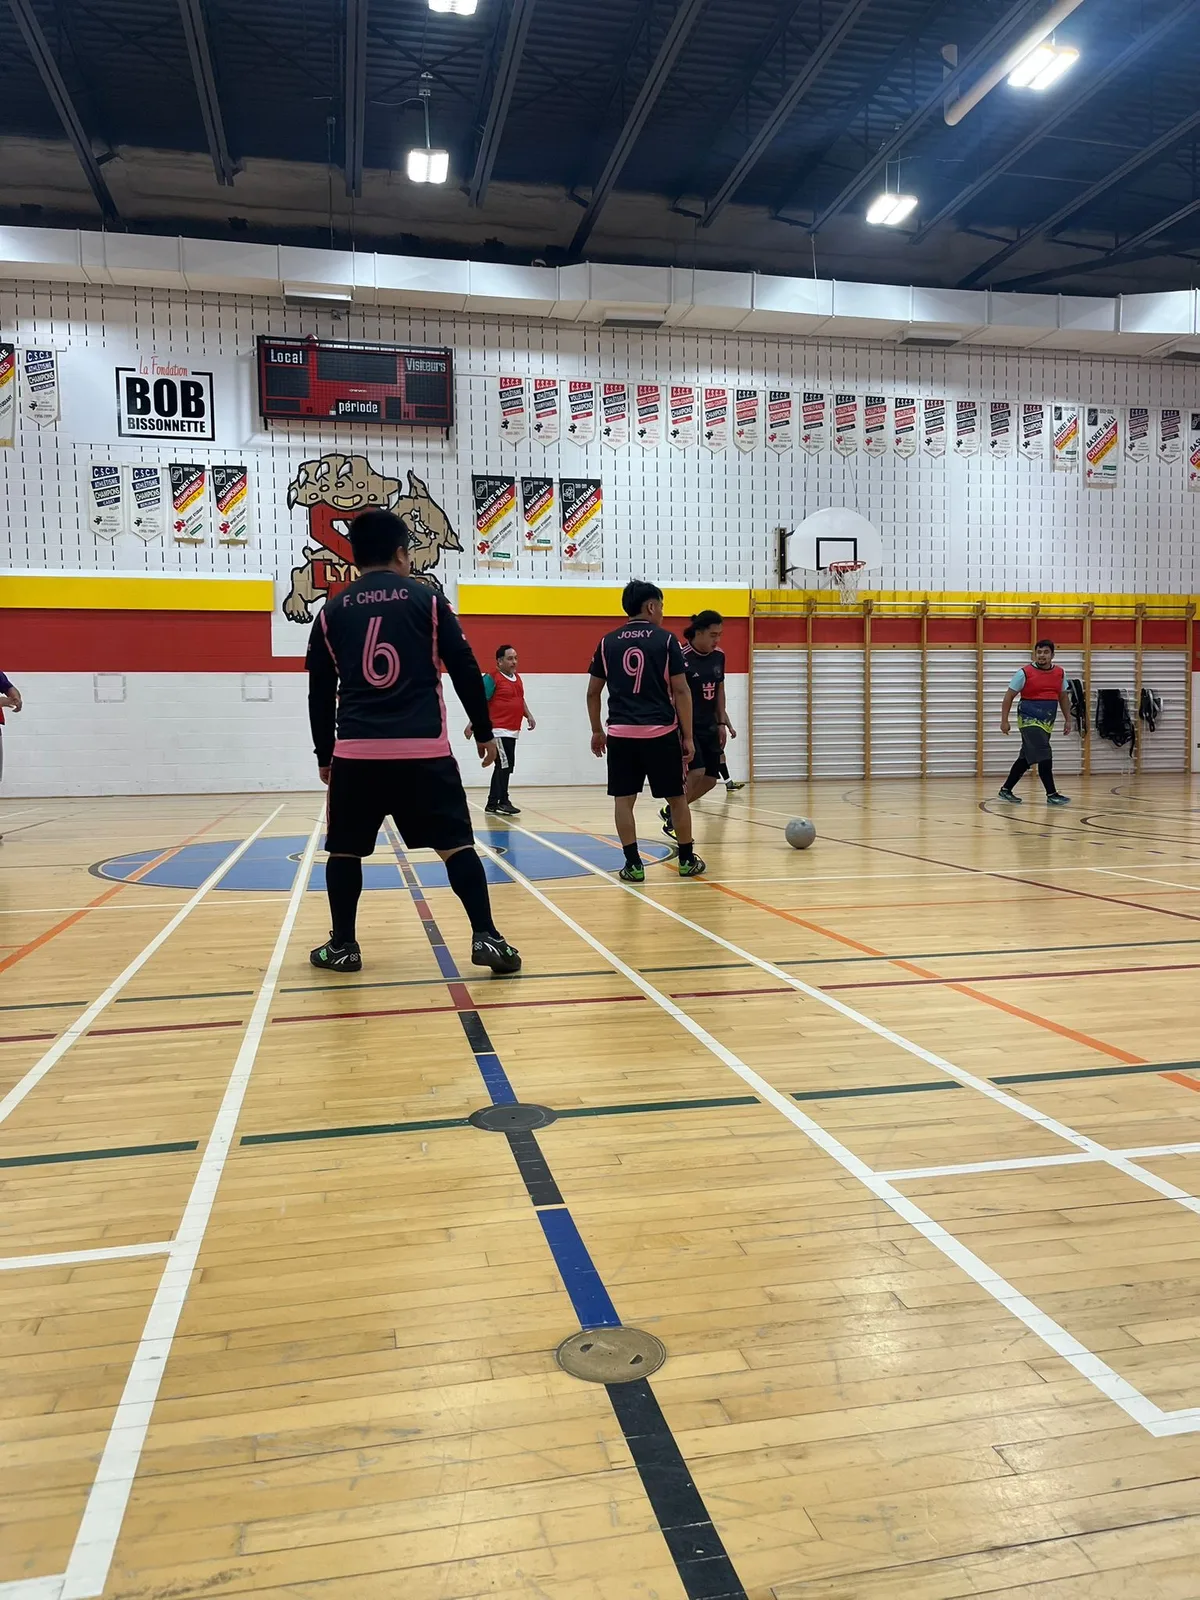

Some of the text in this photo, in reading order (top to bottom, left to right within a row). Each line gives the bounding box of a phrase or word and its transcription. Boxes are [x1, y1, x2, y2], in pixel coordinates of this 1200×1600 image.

[140, 355, 188, 376] La Fondation
[270, 349, 302, 364] Local
[405, 357, 446, 372] Visiteurs
[28, 372, 54, 384] CHAMPIONS
[126, 377, 205, 418] BOB
[338, 401, 378, 415] période
[571, 402, 593, 412] CHAMPIONS
[604, 405, 625, 416] CHAMPIONS
[128, 417, 206, 433] BISSONNETTE
[671, 407, 692, 417] CHAMPIONS
[1086, 416, 1116, 448] BASKET-BALL
[1088, 429, 1115, 459] CHAMPIONS
[95, 487, 119, 499] CHAMPIONS
[136, 488, 160, 500] CHAMPIONS
[174, 470, 201, 497] BASKET-BALL
[174, 480, 202, 507] CHAMPIONNES
[217, 472, 244, 498] VOLLEY-BALL
[218, 481, 245, 509] CHAMPIONNES
[477, 482, 510, 515] BASKET-BALL
[477, 493, 511, 527] CHAMPIONS
[525, 484, 550, 510] BASKET-BALL
[525, 493, 550, 520] CHAMPIONS
[564, 485, 596, 519] ATHLÉTISME
[565, 496, 597, 531] CHAMPIONS
[343, 588, 409, 607] F. CHOLAC
[617, 630, 653, 639] JOSKY
[362, 616, 400, 689] 6
[622, 646, 645, 694] 9
